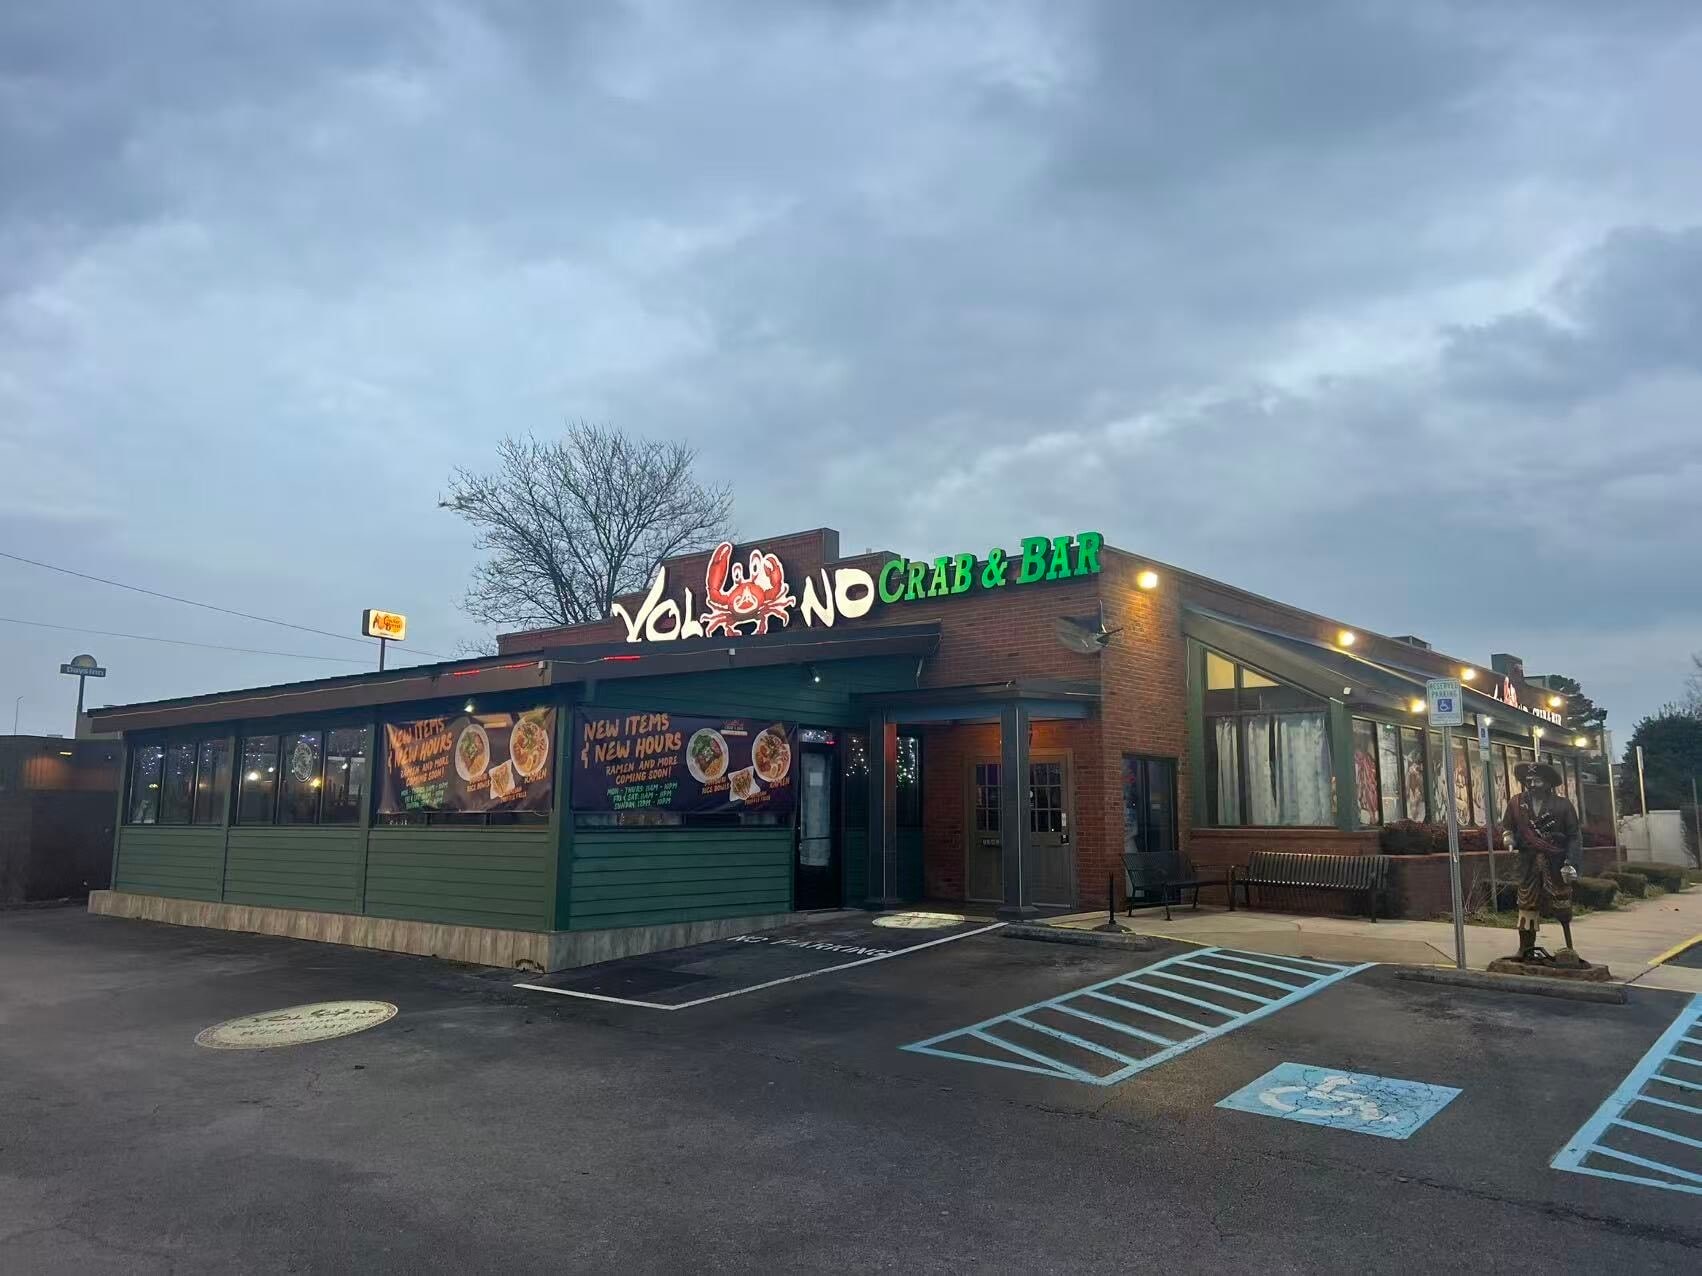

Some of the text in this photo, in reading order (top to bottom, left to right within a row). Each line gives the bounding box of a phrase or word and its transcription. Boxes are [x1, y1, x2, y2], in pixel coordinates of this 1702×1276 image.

[878, 531, 1104, 604] CRAB & BAR
[1429, 682, 1460, 690] RESERVED
[1431, 690, 1459, 698] PARKING
[584, 712, 670, 742] NEW ITEMS
[420, 731, 453, 761] HOURS
[595, 739, 631, 763] NEW
[635, 731, 682, 759] HOURS
[606, 755, 679, 776] RAMEN AND MORE
[615, 766, 672, 785] COMING SOON!
